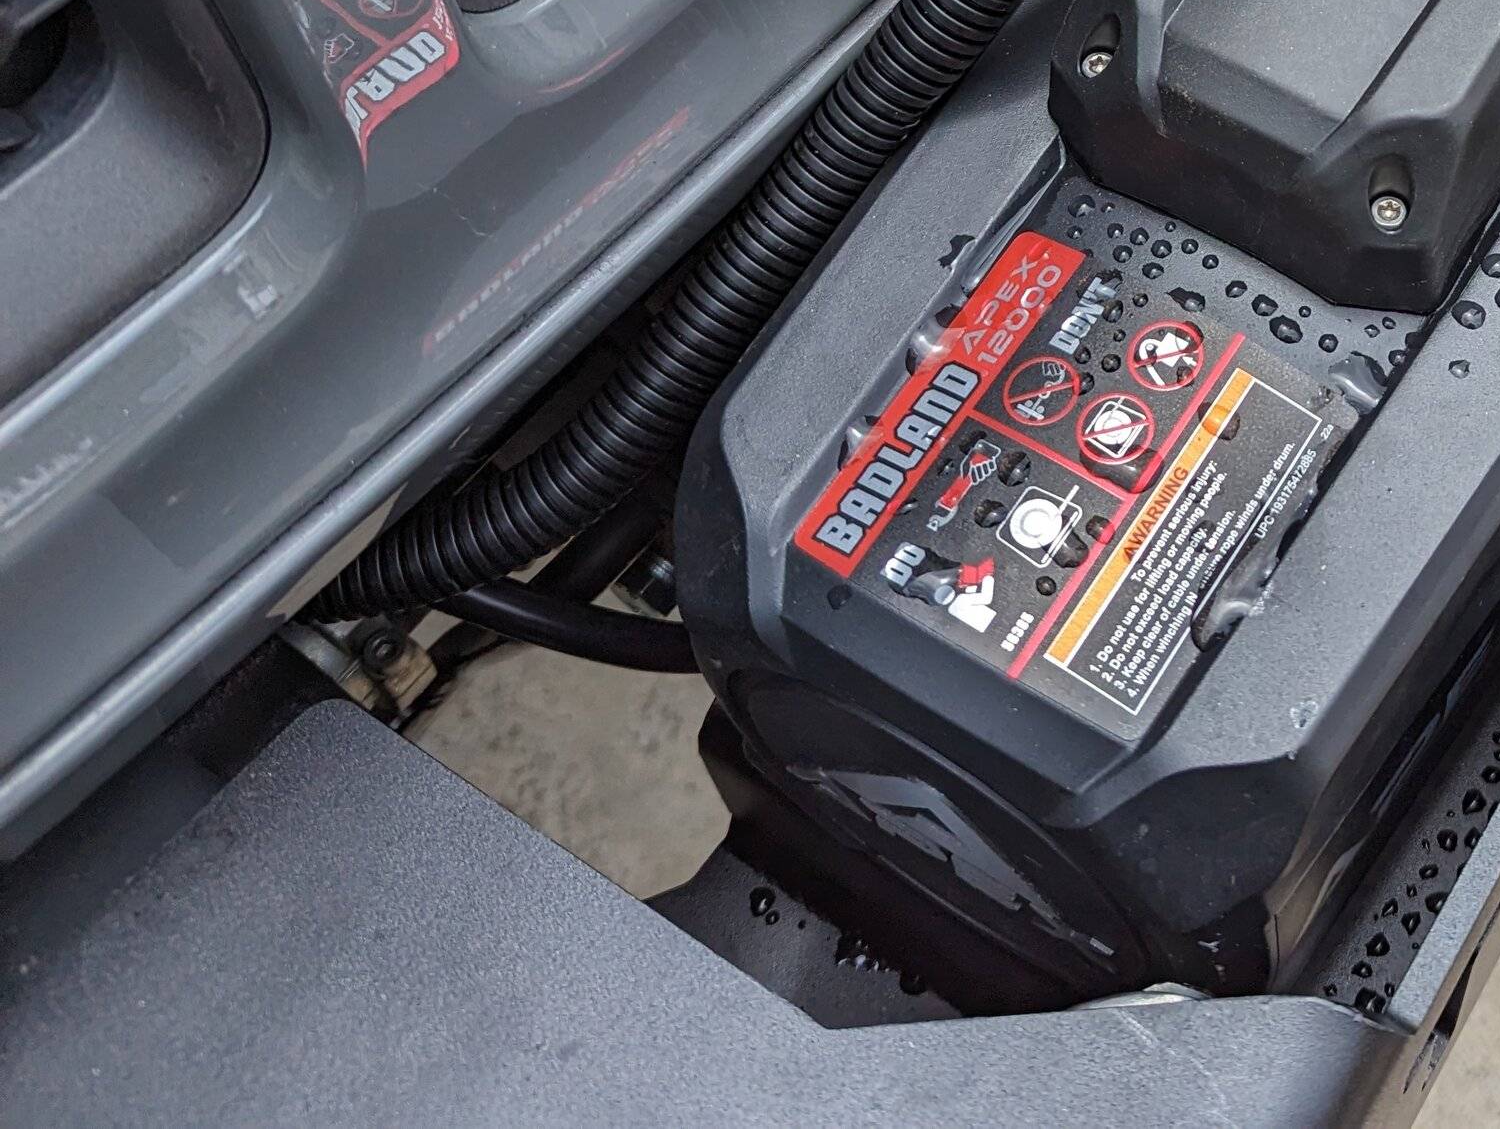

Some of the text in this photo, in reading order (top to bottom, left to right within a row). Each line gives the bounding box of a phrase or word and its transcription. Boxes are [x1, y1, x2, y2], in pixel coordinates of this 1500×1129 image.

[961, 253, 1039, 355] APEX
[975, 263, 1062, 362] 12000
[1048, 275, 1117, 355] DON'T
[814, 361, 979, 554] BADLAND
[1127, 464, 1190, 548] WARNING
[879, 540, 926, 586] DO
[1087, 469, 1230, 673] 1. Do not use for lifting or moving people.
[1124, 683, 1140, 698] 4.
[1132, 651, 1160, 686] When
[1152, 603, 1193, 655] winching
[1218, 528, 1241, 556] rope
[1232, 496, 1259, 530] winds
[1251, 468, 1277, 500] under
[1270, 438, 1296, 471] drum.
[1129, 459, 1220, 583] To prevent serious injury:
[1253, 513, 1275, 540] UPC
[1100, 524, 1209, 682] 2. Do not exceed load capacity.
[1112, 675, 1127, 690] 3.
[1120, 646, 1148, 679] Keep
[1139, 619, 1163, 649] clear
[1157, 606, 1172, 621] of
[1165, 577, 1191, 609] cable
[1184, 548, 1210, 579] under
